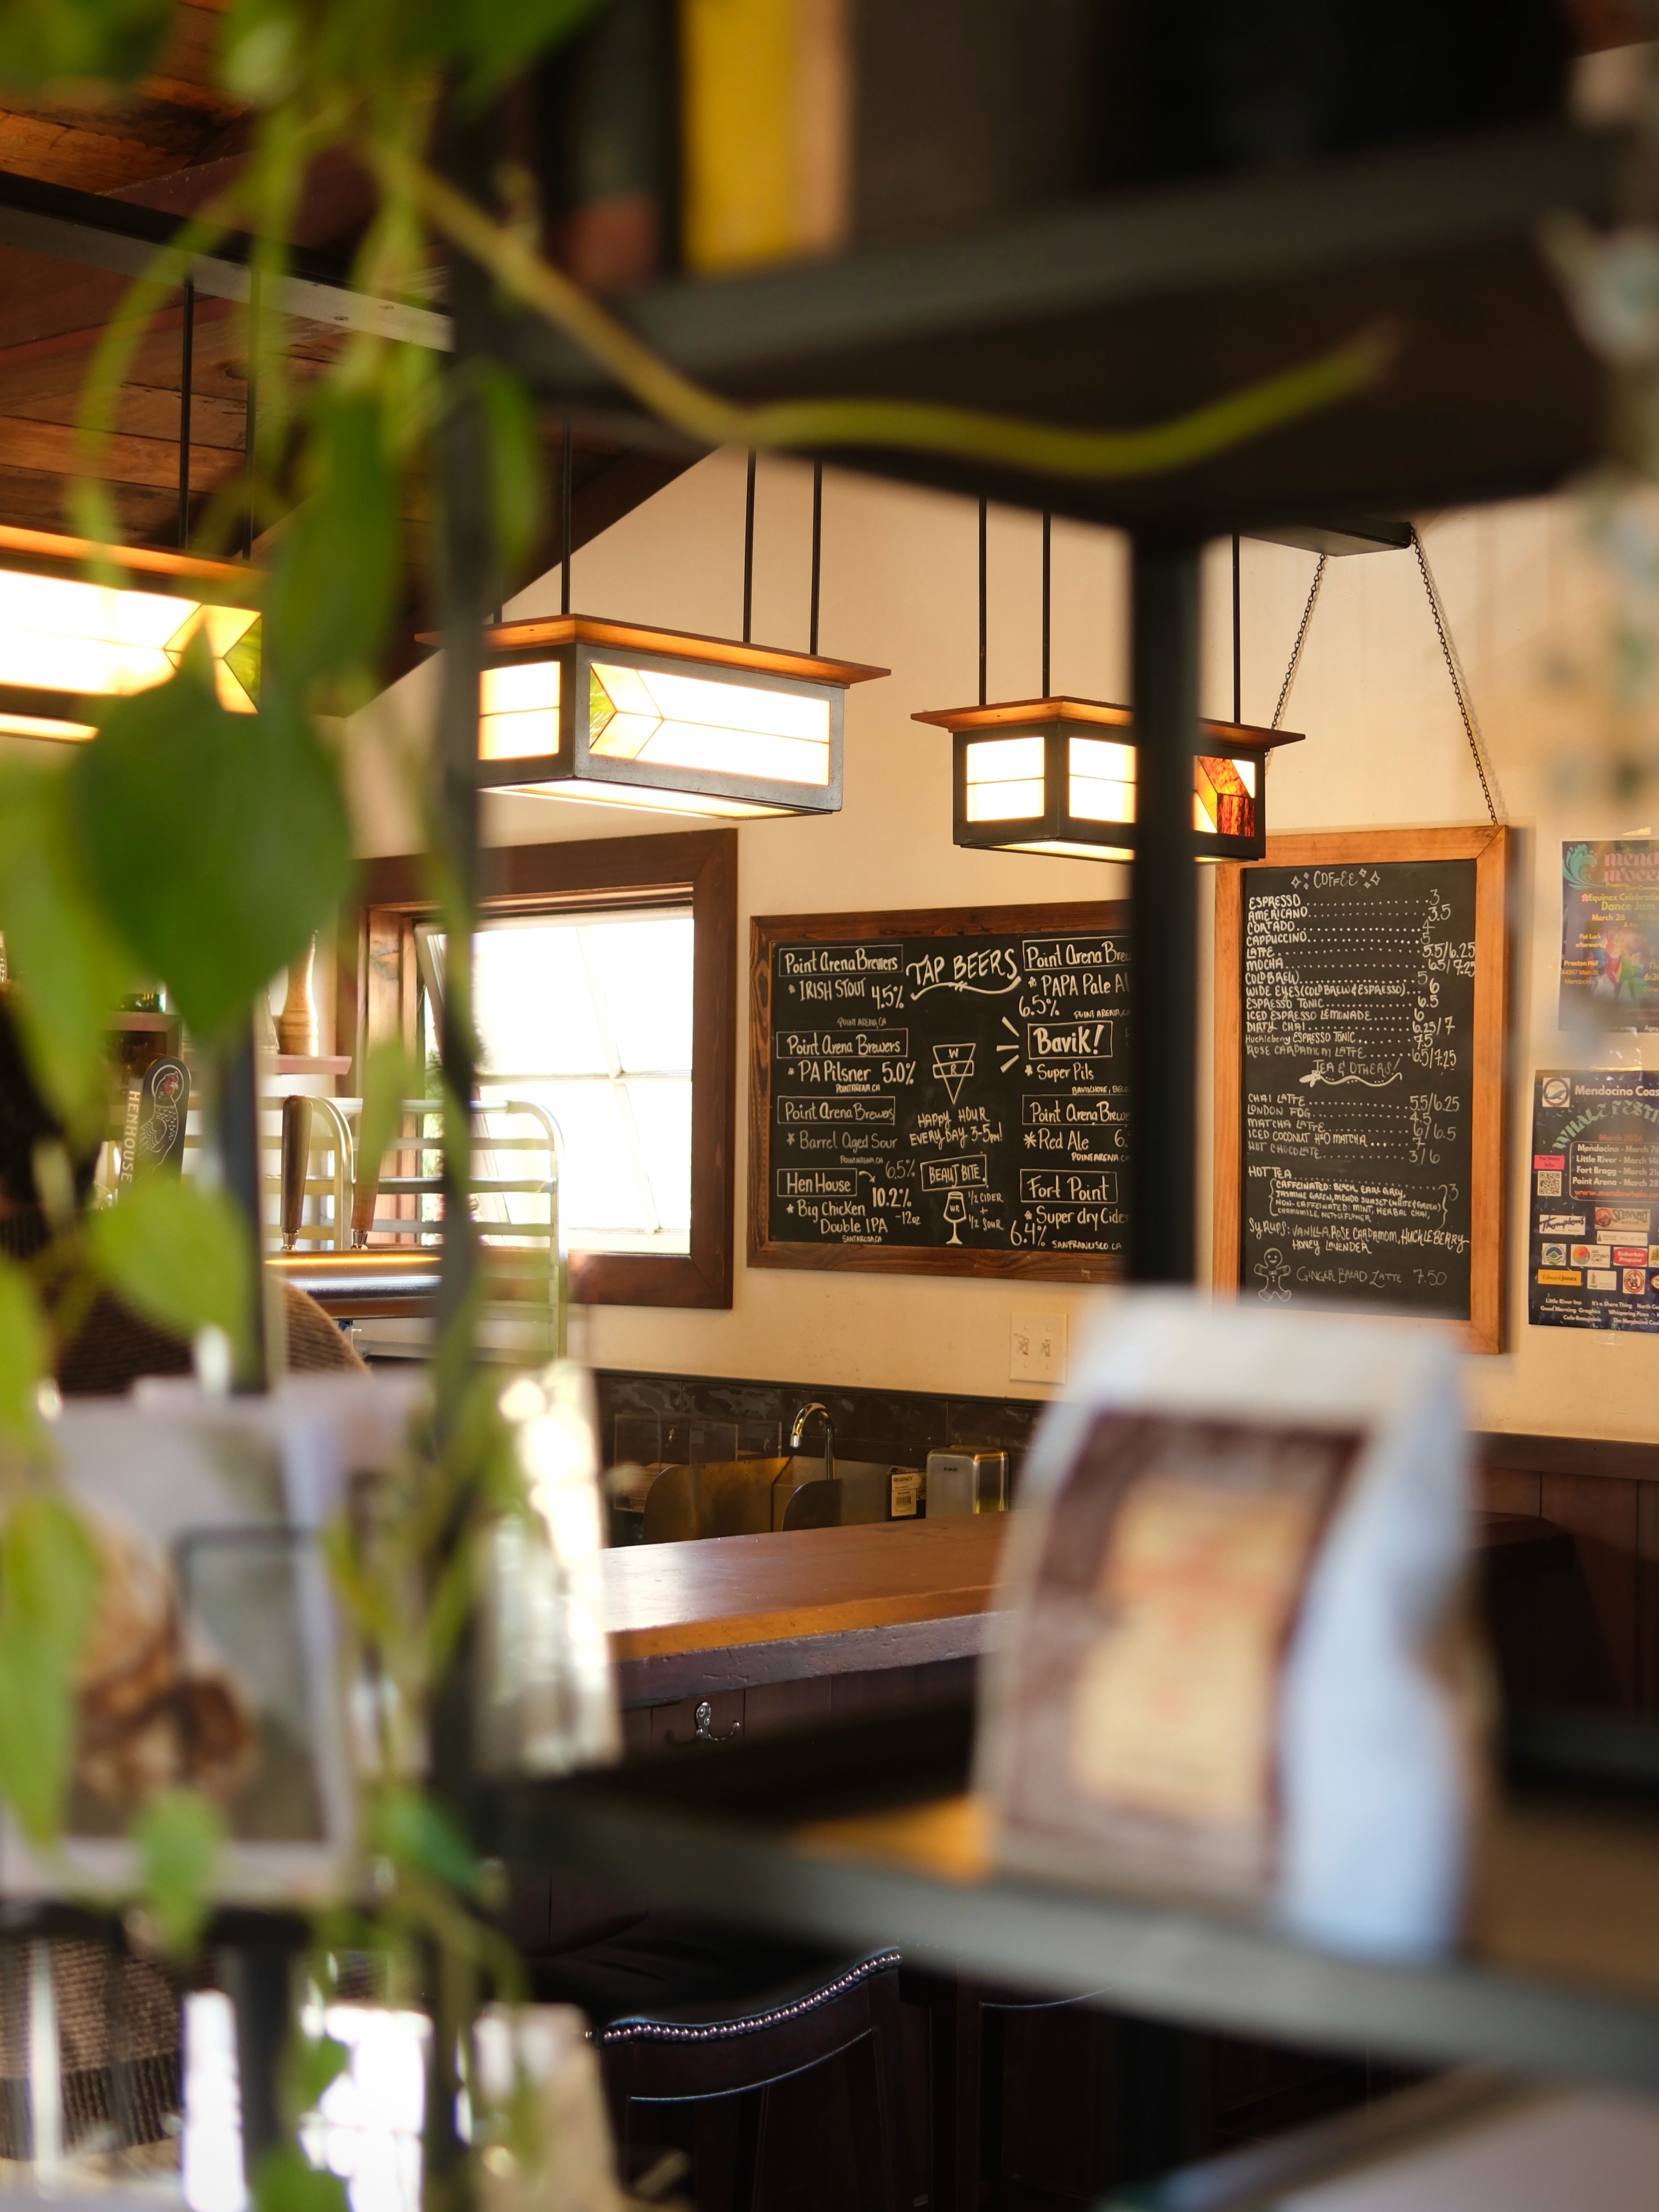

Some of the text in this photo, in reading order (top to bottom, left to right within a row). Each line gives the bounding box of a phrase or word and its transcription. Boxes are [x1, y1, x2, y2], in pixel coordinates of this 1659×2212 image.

[1313, 870, 1358, 889] COFFEE
[1249, 888, 1440, 910] ESPRESSO 3
[1601, 901, 1631, 911] Dance
[1248, 903, 1451, 924] AMERICANO 3.5
[1247, 921, 1295, 935] CORTADO
[1246, 930, 1307, 947] CAPPUCCINO
[855, 948, 898, 971] Brewers
[1026, 944, 1062, 969] Point
[1246, 946, 1274, 959] LATTE
[906, 948, 1017, 987] TAP BEERS
[1246, 957, 1284, 972] MOCHA
[799, 977, 905, 1010] IRISH STOUT 4.5%
[1041, 973, 1111, 997] PAPA Pale
[1246, 985, 1272, 996] WIDE
[1429, 977, 1440, 994] 6
[1019, 994, 1060, 1017] 6.5%
[1246, 995, 1439, 1010] ESPRESSO TONIC 6.5
[1246, 1008, 1425, 1022] ICED ESPRESSO LEMONADE 6
[1246, 1021, 1305, 1033] DIRTY CHAI
[787, 1032, 820, 1056] Point
[855, 1034, 900, 1056] Brewers
[1292, 1031, 1331, 1044] ESPRESSO
[1332, 1031, 1356, 1043] TONIC
[1246, 1045, 1271, 1058] ROSE
[1334, 1046, 1367, 1058] LATTE
[882, 1061, 916, 1085] 5.0%
[1036, 1062, 1094, 1083] Super Pils
[1312, 1059, 1334, 1074] TEA
[1574, 1085, 1634, 1096] Mendocino
[1248, 1093, 1271, 1103] CHAI
[1277, 1093, 1306, 1107] LATTE
[785, 1102, 818, 1121] Point
[958, 1106, 990, 1122] HOUR
[1029, 1100, 1061, 1123] Point
[1247, 1103, 1284, 1116] LONDON
[1290, 1107, 1311, 1118] FOG
[1247, 1117, 1291, 1129] MATCHA
[799, 1130, 838, 1149] Barrel
[871, 1133, 898, 1149] Sour
[909, 1129, 945, 1150] EVERY
[945, 1127, 968, 1149] DAY
[1037, 1128, 1090, 1151] Red Ale
[1248, 1129, 1270, 1139] ICED
[1272, 1131, 1311, 1143] COCONUT
[1247, 1141, 1267, 1151] HOT
[1577, 1144, 1649, 1154] Mendocino March
[1576, 1155, 1647, 1165] Little River March
[1576, 1165, 1647, 1177] Fort Bragg March
[1026, 1175, 1109, 1201] Fort Point
[1248, 1165, 1459, 1201] HOT TEA 3
[1572, 1177, 1647, 1188] Point Arena March
[872, 1186, 912, 1208] 10.2%
[980, 1192, 1004, 1202] CIDER
[797, 1199, 819, 1223] Big
[1036, 1205, 1075, 1230] Super
[1077, 1207, 1099, 1232] dry
[820, 1217, 888, 1234] Double IPA
[1010, 1220, 1048, 1247] 6.4%
[1291, 1239, 1373, 1256] HONEY LAVENDER
[1413, 1269, 1447, 1286] 7.50
